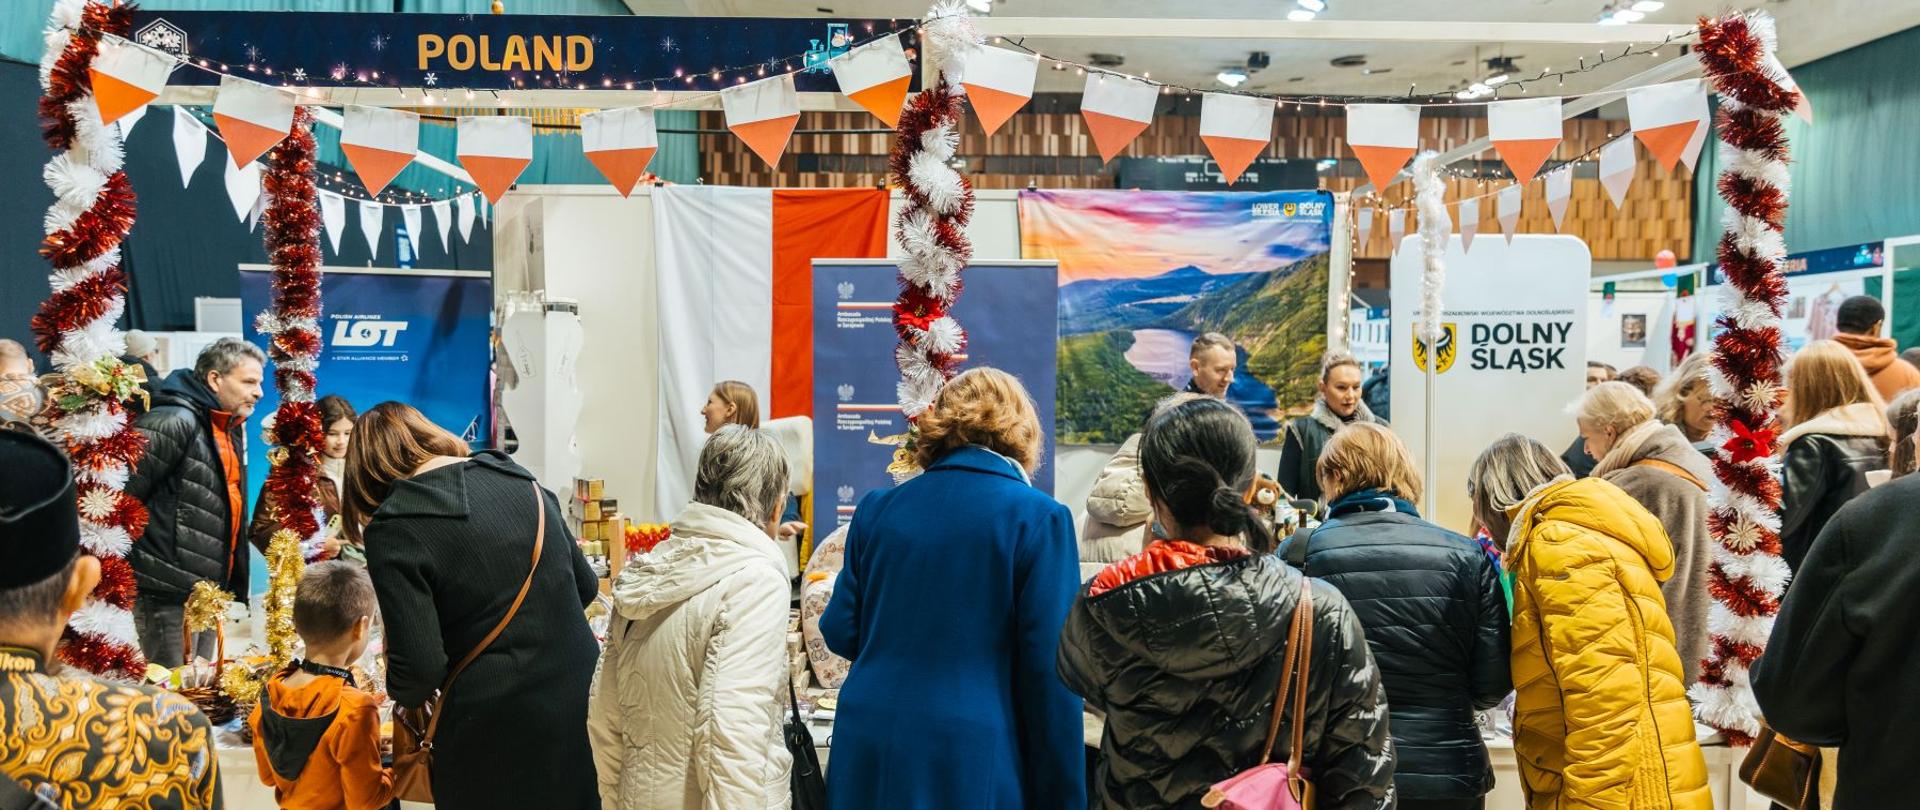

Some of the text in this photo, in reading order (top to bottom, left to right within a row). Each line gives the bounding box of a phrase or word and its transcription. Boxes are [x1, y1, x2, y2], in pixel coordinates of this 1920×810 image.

[418, 34, 594, 71] POLAND
[331, 320, 408, 347] LOT
[1471, 322, 1573, 345] DOLNY
[1470, 343, 1566, 373] ŚLĄSK
